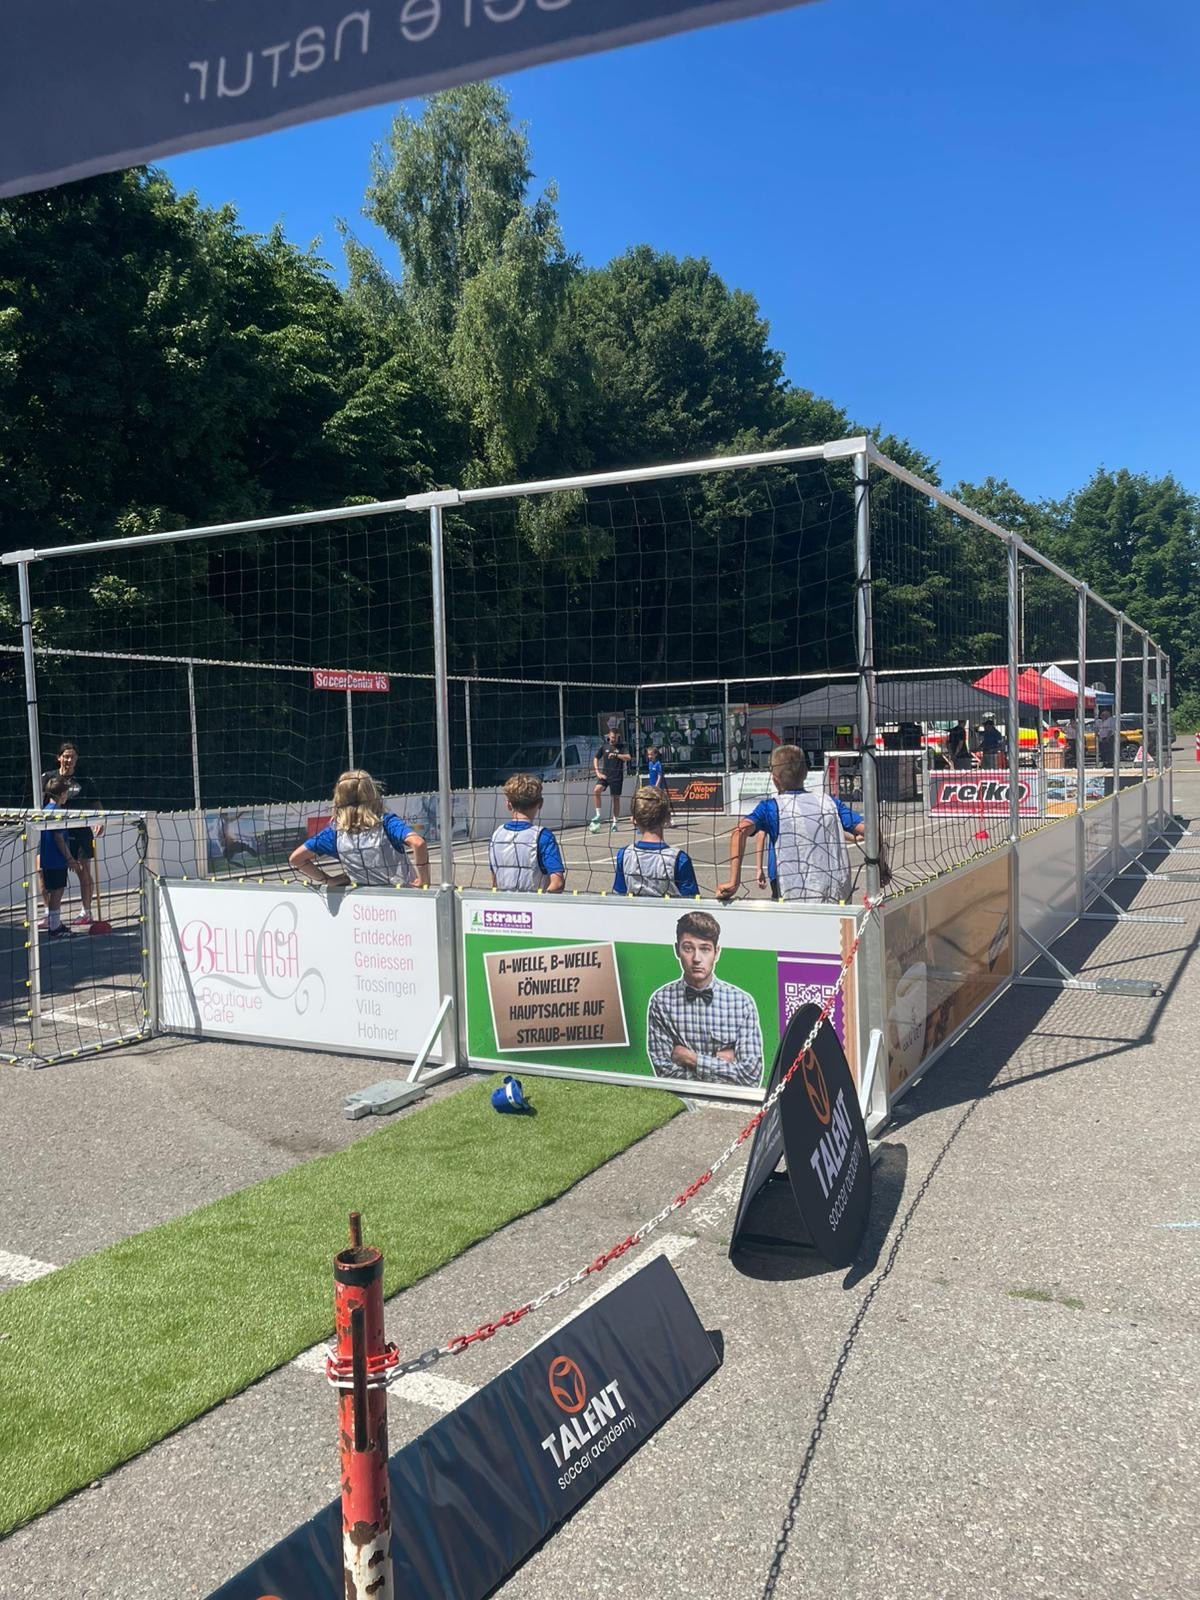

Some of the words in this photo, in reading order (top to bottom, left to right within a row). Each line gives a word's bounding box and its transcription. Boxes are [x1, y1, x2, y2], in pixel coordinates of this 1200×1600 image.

[316, 672, 373, 689] SoccerCenter
[375, 676, 387, 689] VS
[689, 792, 710, 800] Dach
[693, 785, 717, 793] Weber
[942, 781, 1027, 802] reiko
[353, 903, 397, 922] Stöbern
[485, 911, 531, 924] straub
[354, 927, 412, 946] Entdecken
[354, 951, 414, 971] Geniessen
[498, 955, 547, 975] A-WELLE,
[550, 951, 601, 970] B-WELLE,
[355, 975, 416, 998] Trossingen
[518, 976, 580, 996] FÖNWELLE?
[202, 986, 262, 1012] Boutique
[357, 999, 382, 1016] Villa
[509, 1001, 580, 1021] HAUPTSACHE
[583, 999, 605, 1016] AUF
[358, 1021, 399, 1041] Hohner
[516, 1023, 605, 1044] STRAUB-WELLE!
[810, 1087, 853, 1200] TALENT
[829, 1183, 849, 1232] soccer
[845, 1135, 863, 1193] academy
[541, 1379, 626, 1468] TALENT
[558, 1451, 592, 1490] soccer
[590, 1412, 637, 1459] academy
